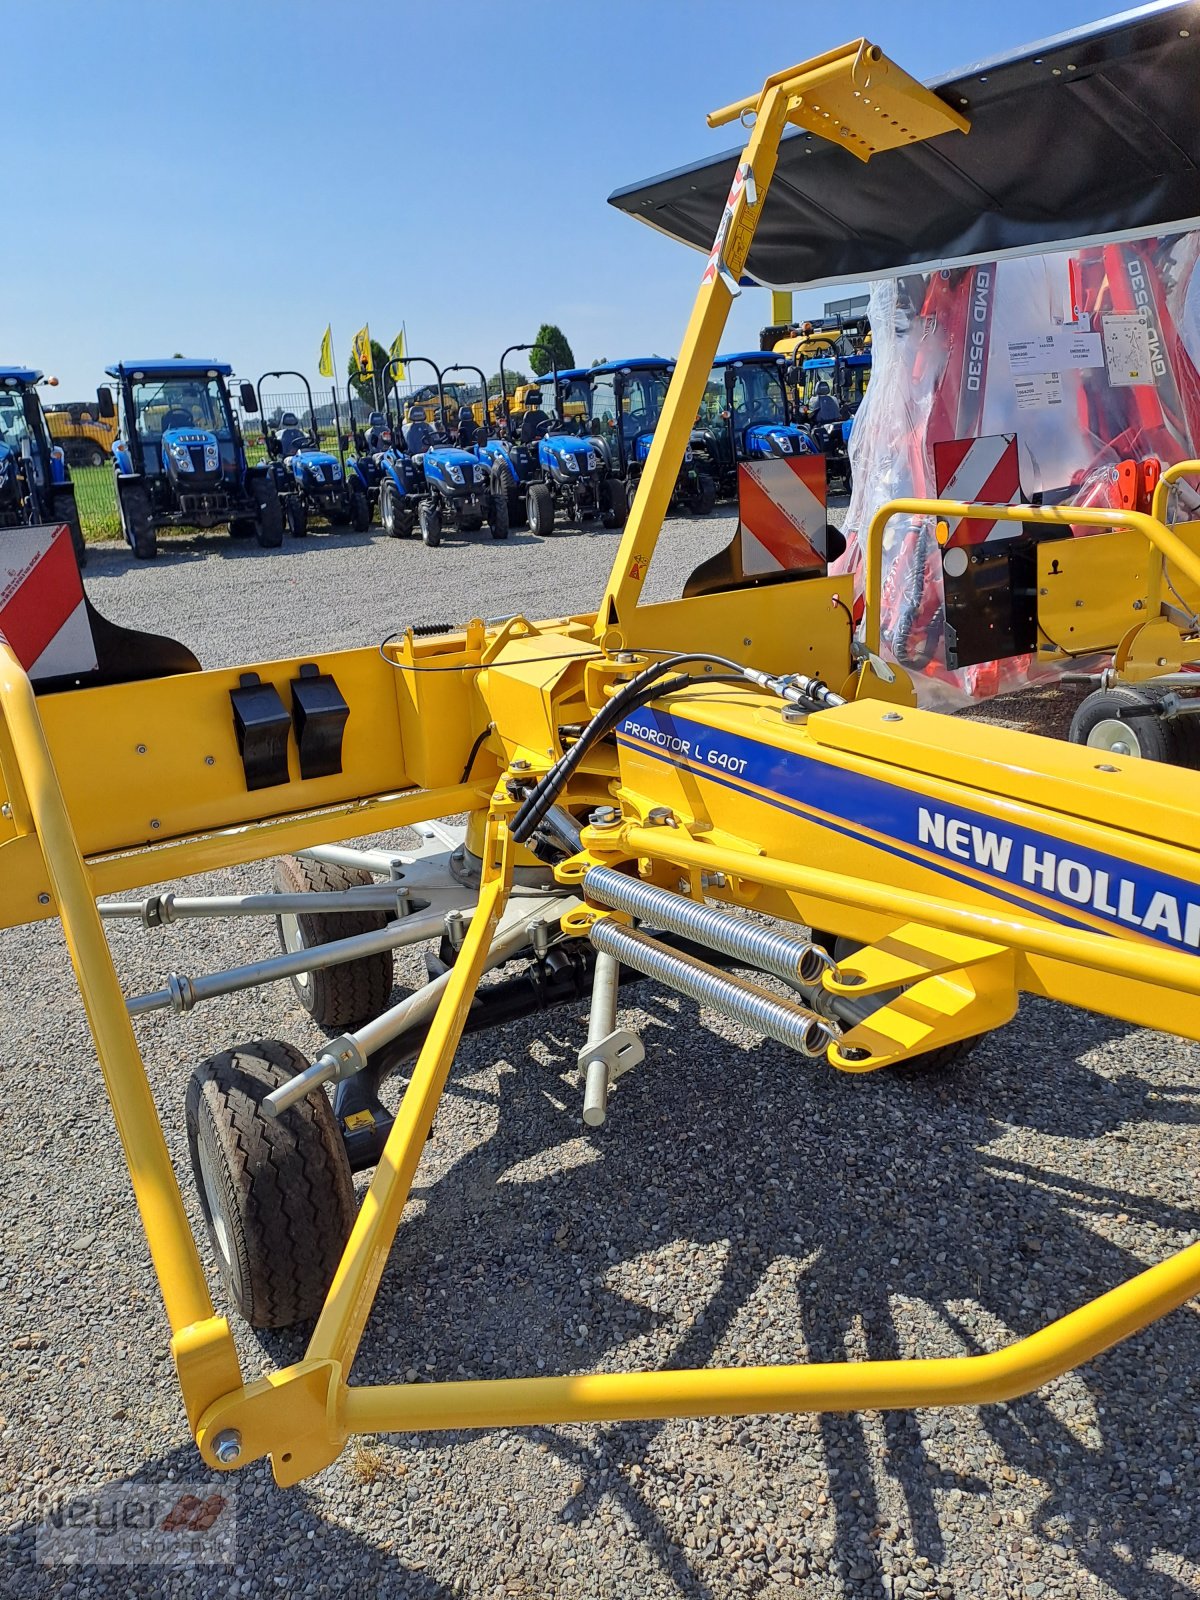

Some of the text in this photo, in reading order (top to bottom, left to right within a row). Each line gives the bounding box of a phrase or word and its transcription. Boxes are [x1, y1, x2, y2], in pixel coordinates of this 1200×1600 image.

[967, 271, 990, 391] GMD 9530
[1147, 328, 1166, 377] GMD
[624, 720, 747, 774] PROROTOR L 640T
[918, 807, 1013, 874] NEW
